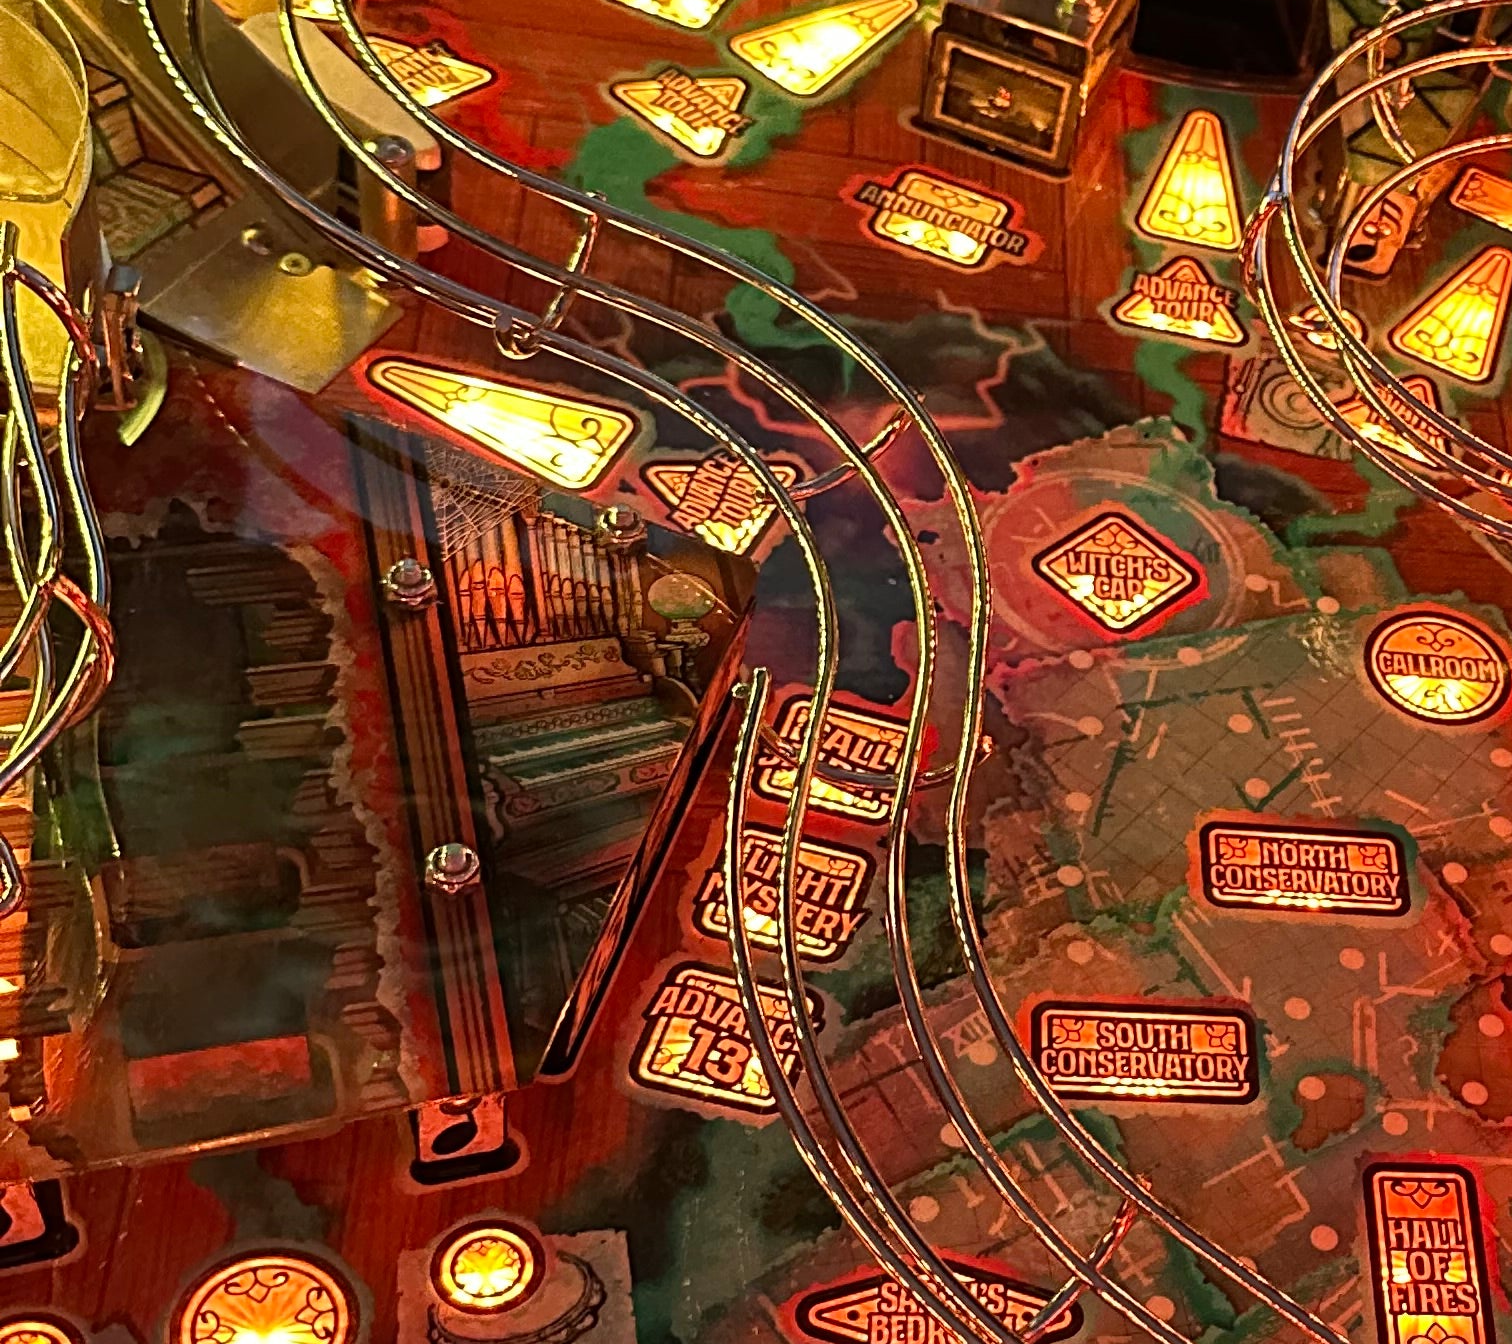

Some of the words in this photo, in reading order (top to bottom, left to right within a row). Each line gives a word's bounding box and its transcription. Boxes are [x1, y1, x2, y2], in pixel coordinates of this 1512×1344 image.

[656, 67, 753, 134] ADVANCE
[858, 184, 1026, 254] ANNUNCIATOR
[1133, 273, 1236, 308] ADVANCE
[1153, 300, 1215, 326] TOUR
[671, 450, 742, 530] ADVANCE
[1068, 550, 1169, 582] WITCH'S
[1095, 576, 1144, 600] CAP
[1379, 651, 1498, 682] CALLROOM
[1262, 840, 1348, 870] NORTH
[744, 846, 852, 906] LIHT
[1210, 863, 1400, 897] CONSERVATORY
[1099, 1021, 1189, 1052] SOUTH
[685, 1024, 751, 1085] 13
[1040, 1048, 1250, 1081] CONSERVATORY
[1387, 1219, 1466, 1250] HALL
[1409, 1251, 1449, 1281] OF
[1390, 1283, 1477, 1314] FIRES
